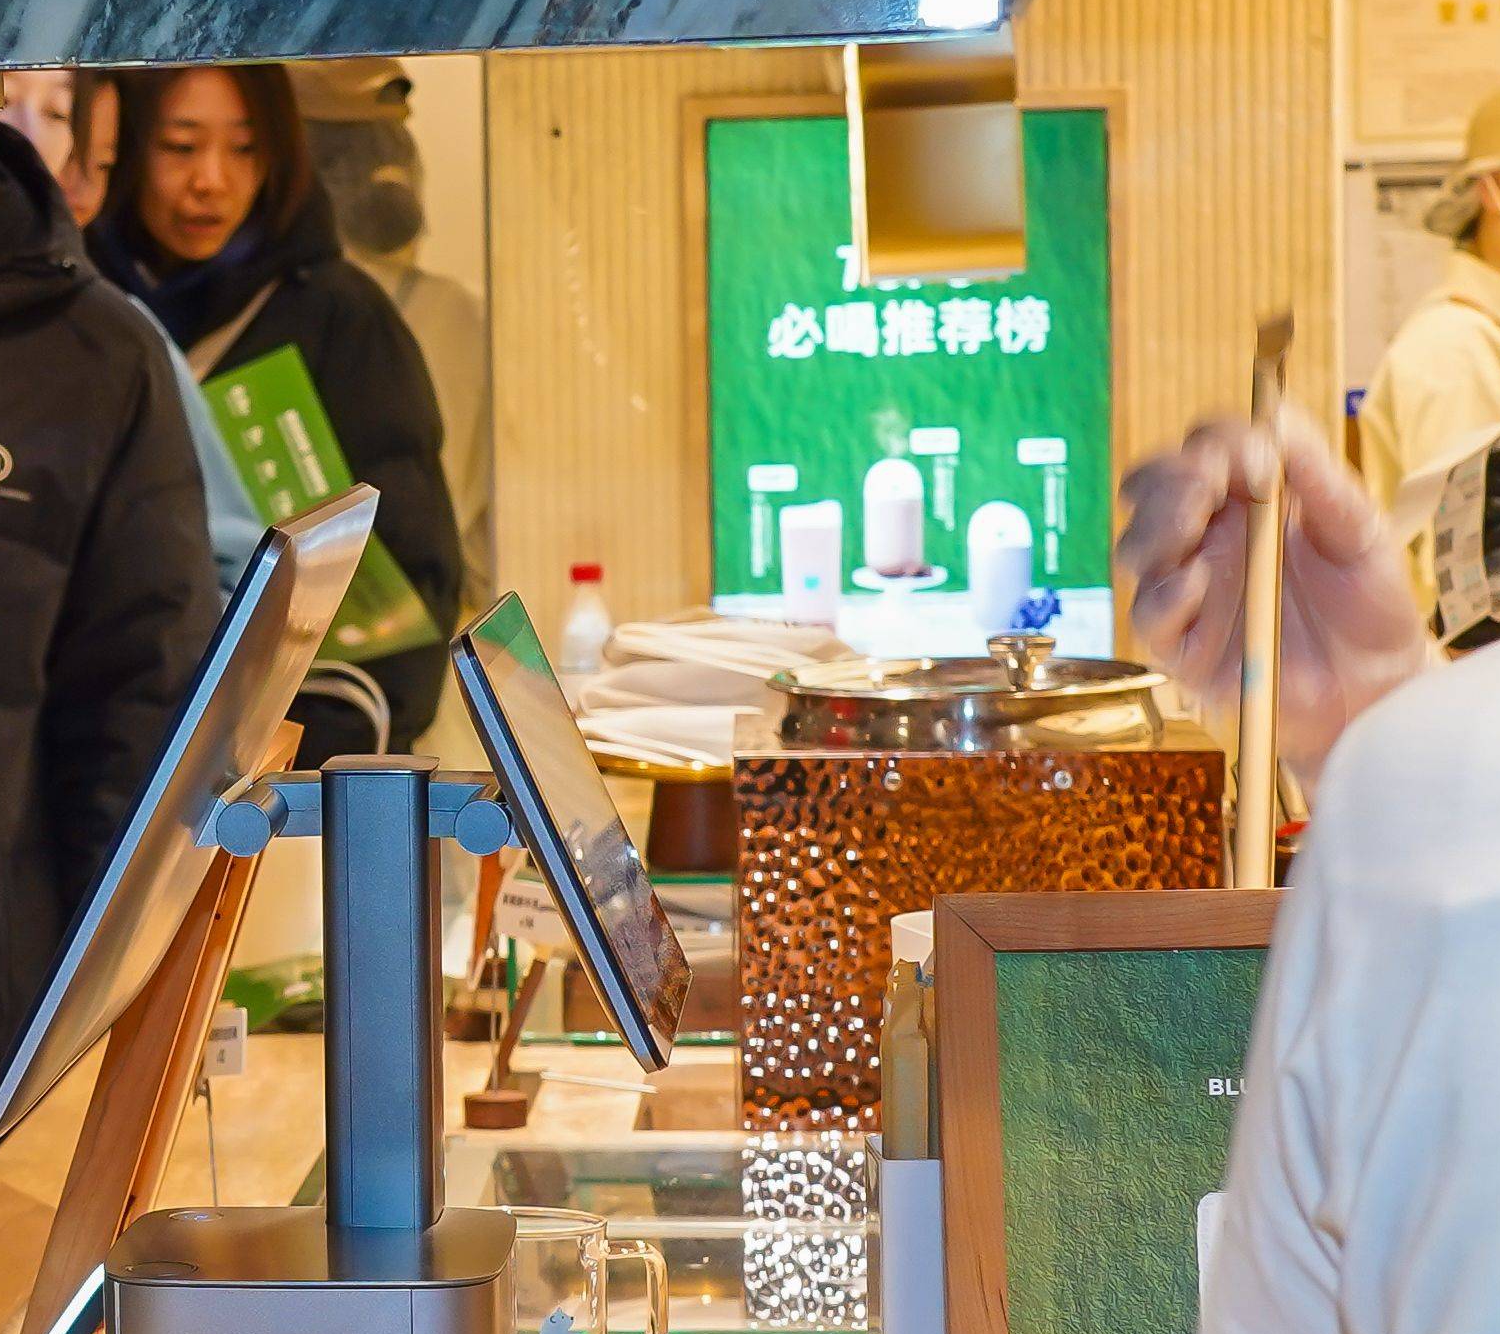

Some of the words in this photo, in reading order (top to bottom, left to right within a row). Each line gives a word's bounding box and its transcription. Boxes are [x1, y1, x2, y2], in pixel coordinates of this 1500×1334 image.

[767, 295, 1051, 359] 必喝推荐榜
